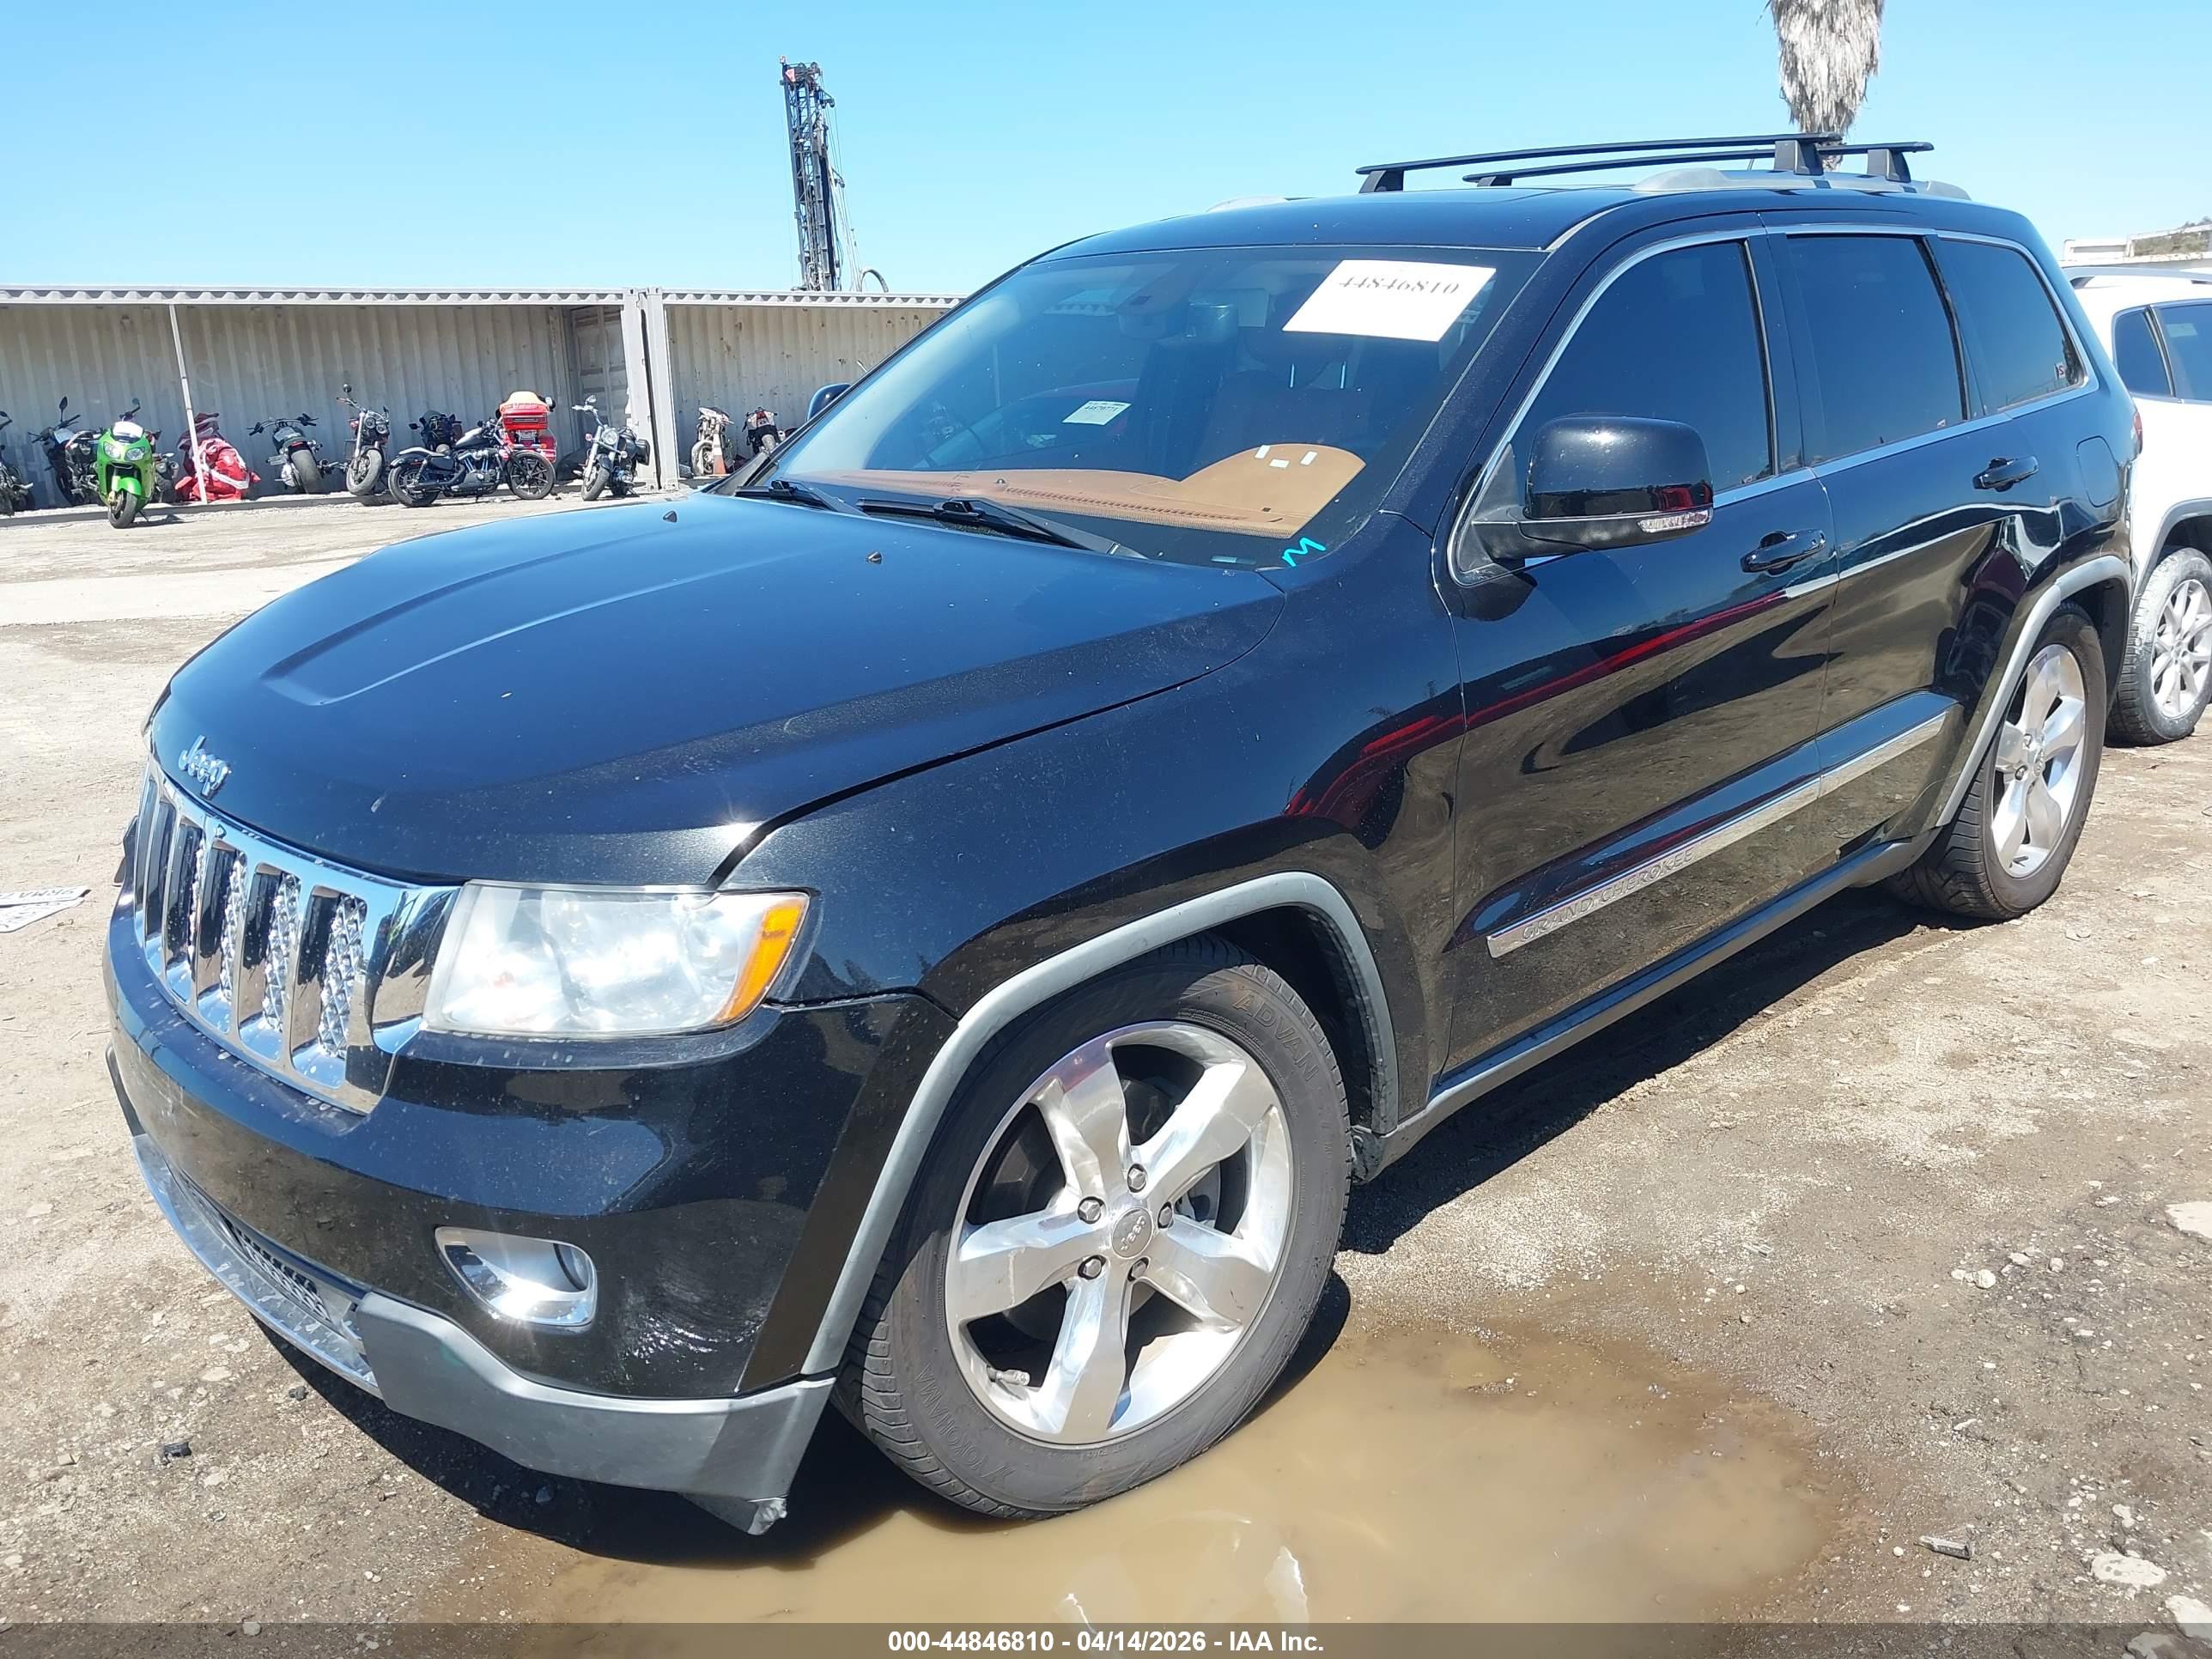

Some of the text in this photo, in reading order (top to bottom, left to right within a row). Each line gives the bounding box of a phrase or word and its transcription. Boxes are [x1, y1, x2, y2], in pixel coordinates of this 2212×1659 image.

[1339, 276, 1460, 295] 44846810
[179, 736, 230, 797] Jeep
[1521, 848, 1696, 941] GRAND CHEROKEE
[1234, 994, 1319, 1082] ADVAN
